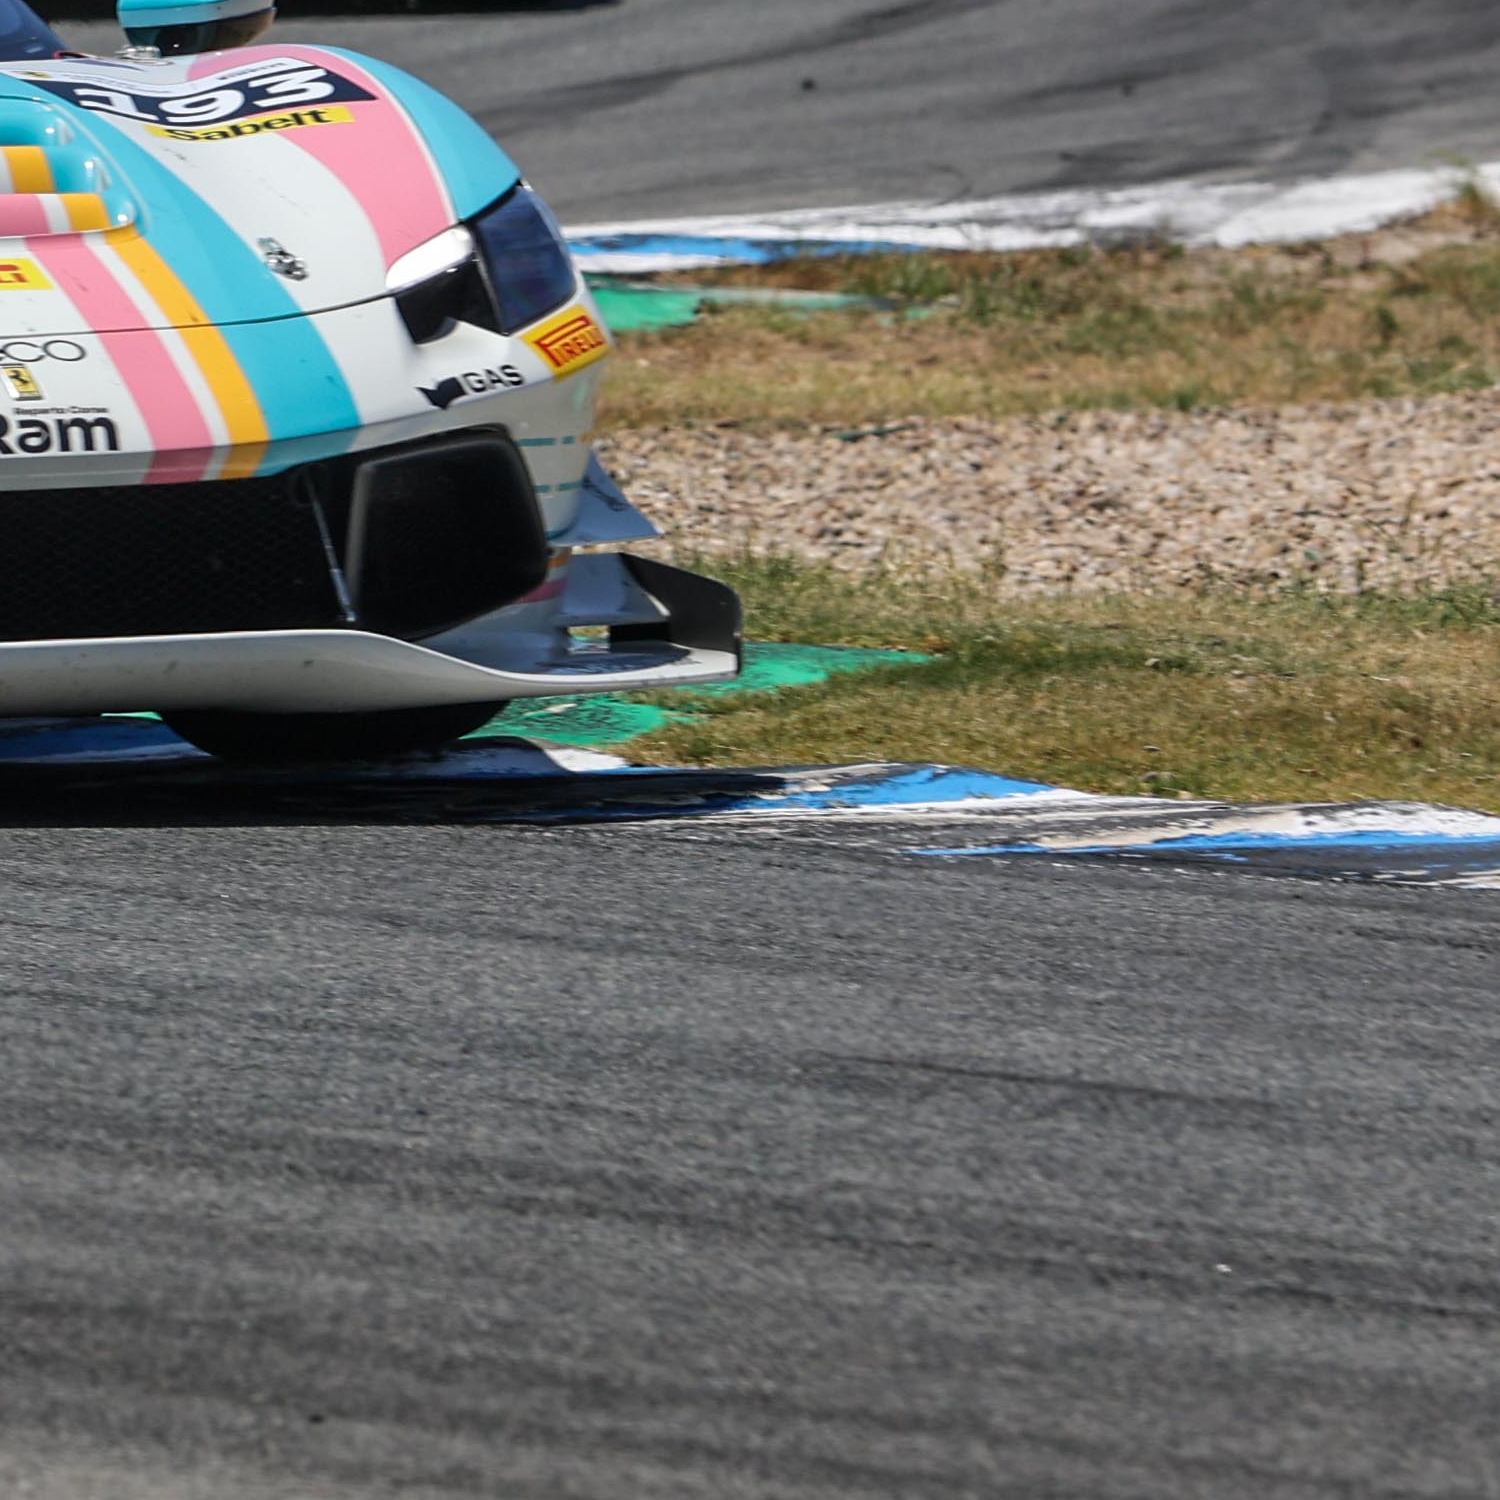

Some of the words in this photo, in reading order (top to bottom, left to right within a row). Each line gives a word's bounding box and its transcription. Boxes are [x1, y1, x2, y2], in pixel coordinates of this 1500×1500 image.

[73, 69, 335, 123] 193
[164, 107, 331, 142] Sabelt
[462, 365, 524, 393] GAS
